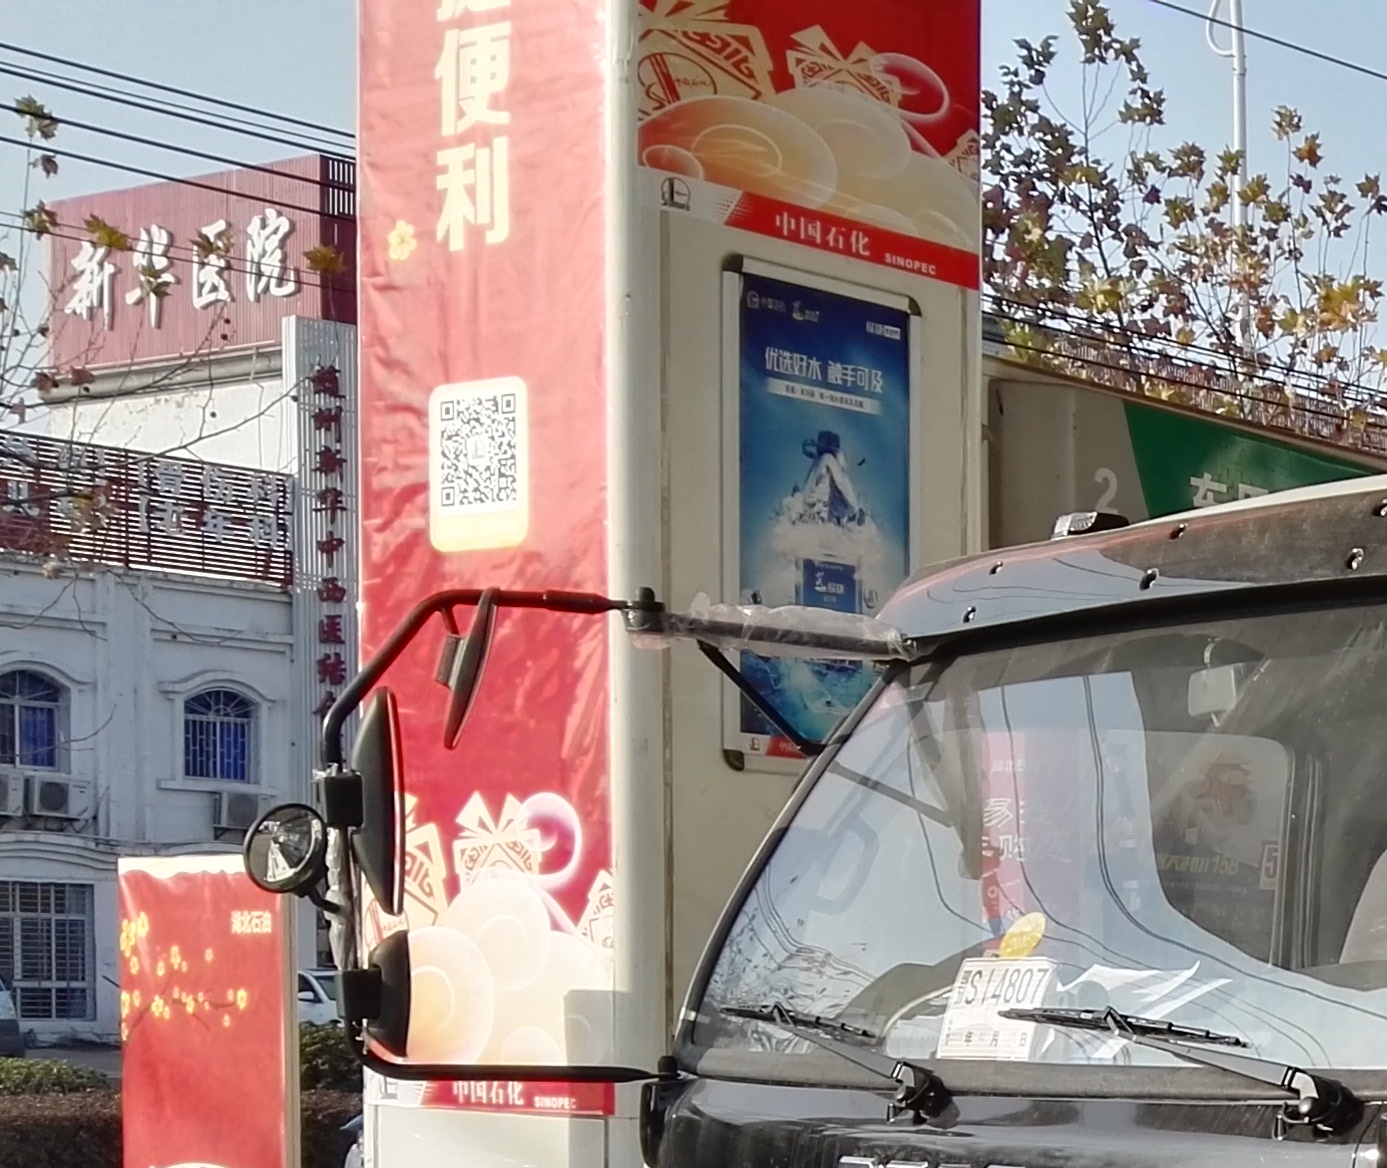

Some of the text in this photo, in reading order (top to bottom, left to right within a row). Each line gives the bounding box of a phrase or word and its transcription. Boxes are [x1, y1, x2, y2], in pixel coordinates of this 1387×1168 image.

[435, 0, 511, 252] 便利
[775, 210, 938, 276] 中国石化 SINOPEC
[63, 207, 297, 331] 新华医院
[765, 346, 823, 382] 优选好水
[1094, 467, 1119, 514] 2
[230, 911, 272, 935] 湖北石油
[453, 1080, 577, 1110] 中国石化 SINOPEC
